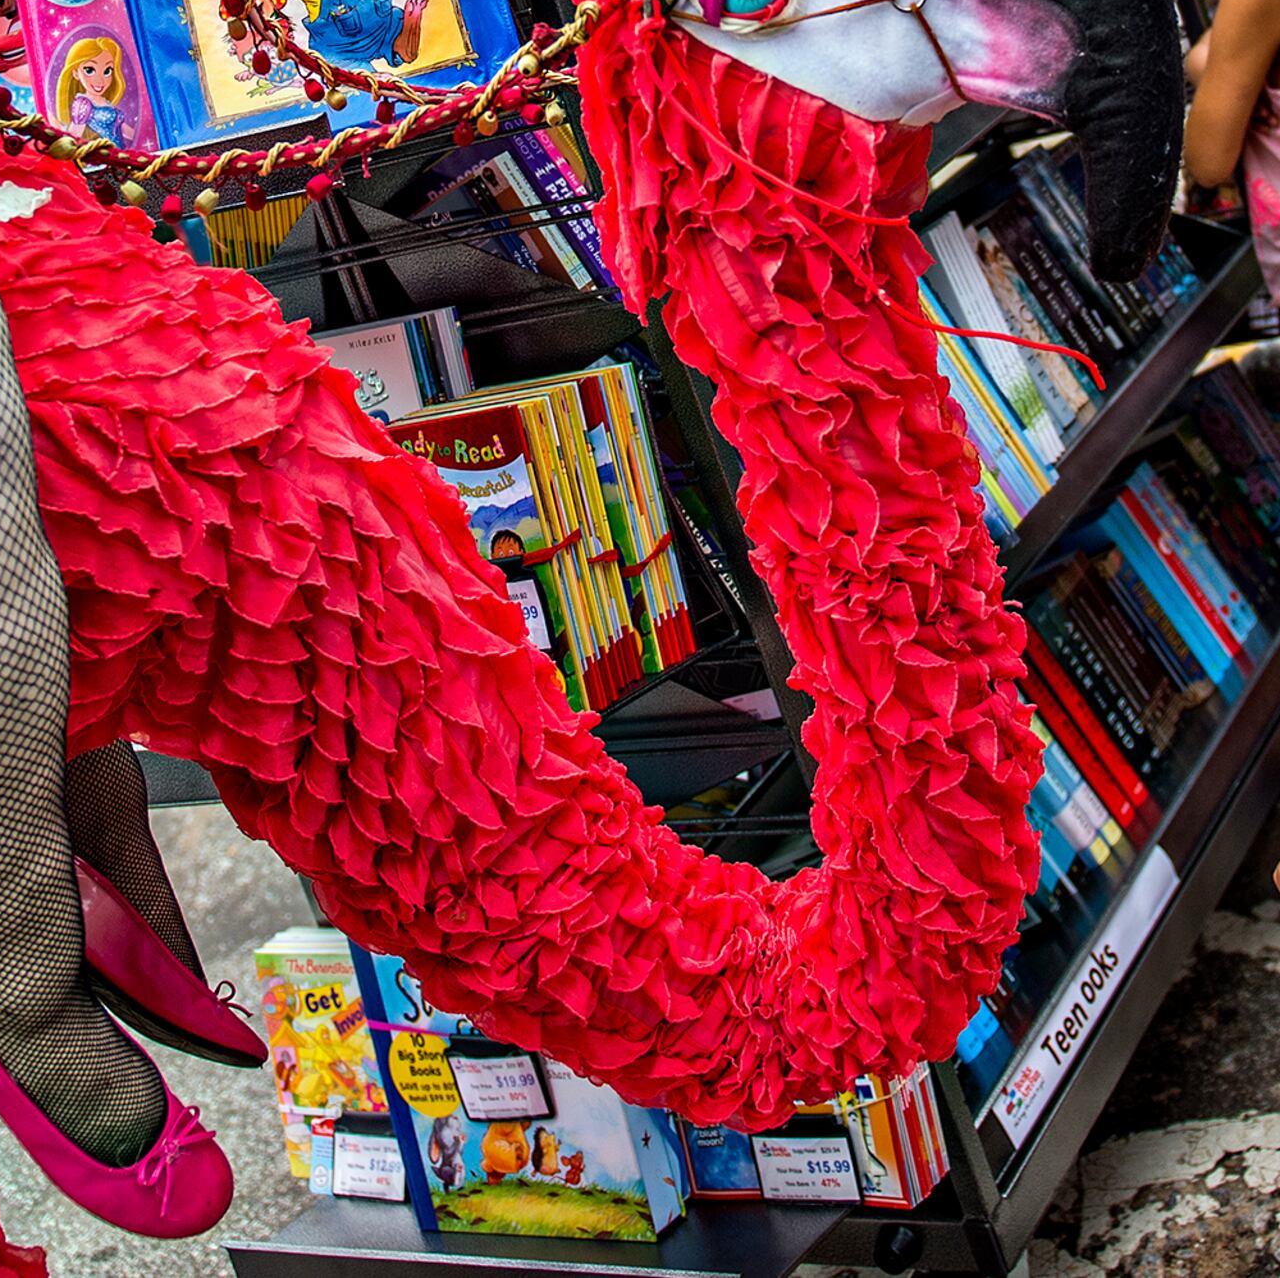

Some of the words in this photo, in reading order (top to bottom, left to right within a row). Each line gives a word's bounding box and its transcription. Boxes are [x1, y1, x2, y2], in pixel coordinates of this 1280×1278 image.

[513, 115, 544, 157] CBOT
[1029, 239, 1055, 269] City
[1058, 278, 1083, 308] Lost
[1076, 306, 1107, 343] Souls
[1015, 250, 1041, 281] City
[1044, 291, 1069, 320] Lost
[1063, 319, 1093, 355] Souls
[349, 338, 371, 350] Miles
[437, 444, 451, 457] to
[454, 434, 506, 463] Read
[1060, 618, 1106, 675] AFTER
[1113, 696, 1147, 736] END
[1050, 633, 1095, 689] AFTER
[1104, 710, 1138, 751] END
[286, 959, 304, 974] The
[305, 987, 342, 1013] Get
[1040, 1002, 1089, 1066] Teen
[1080, 944, 1119, 1005] ooks
[410, 1034, 425, 1048] 10
[398, 1050, 415, 1064] Big
[419, 1049, 445, 1064] Story
[410, 1066, 441, 1076] Books
[496, 1073, 535, 1088] $19.99
[699, 1129, 719, 1138] blue
[807, 1160, 850, 1174] $15.99
[821, 1178, 841, 1187] 47%
